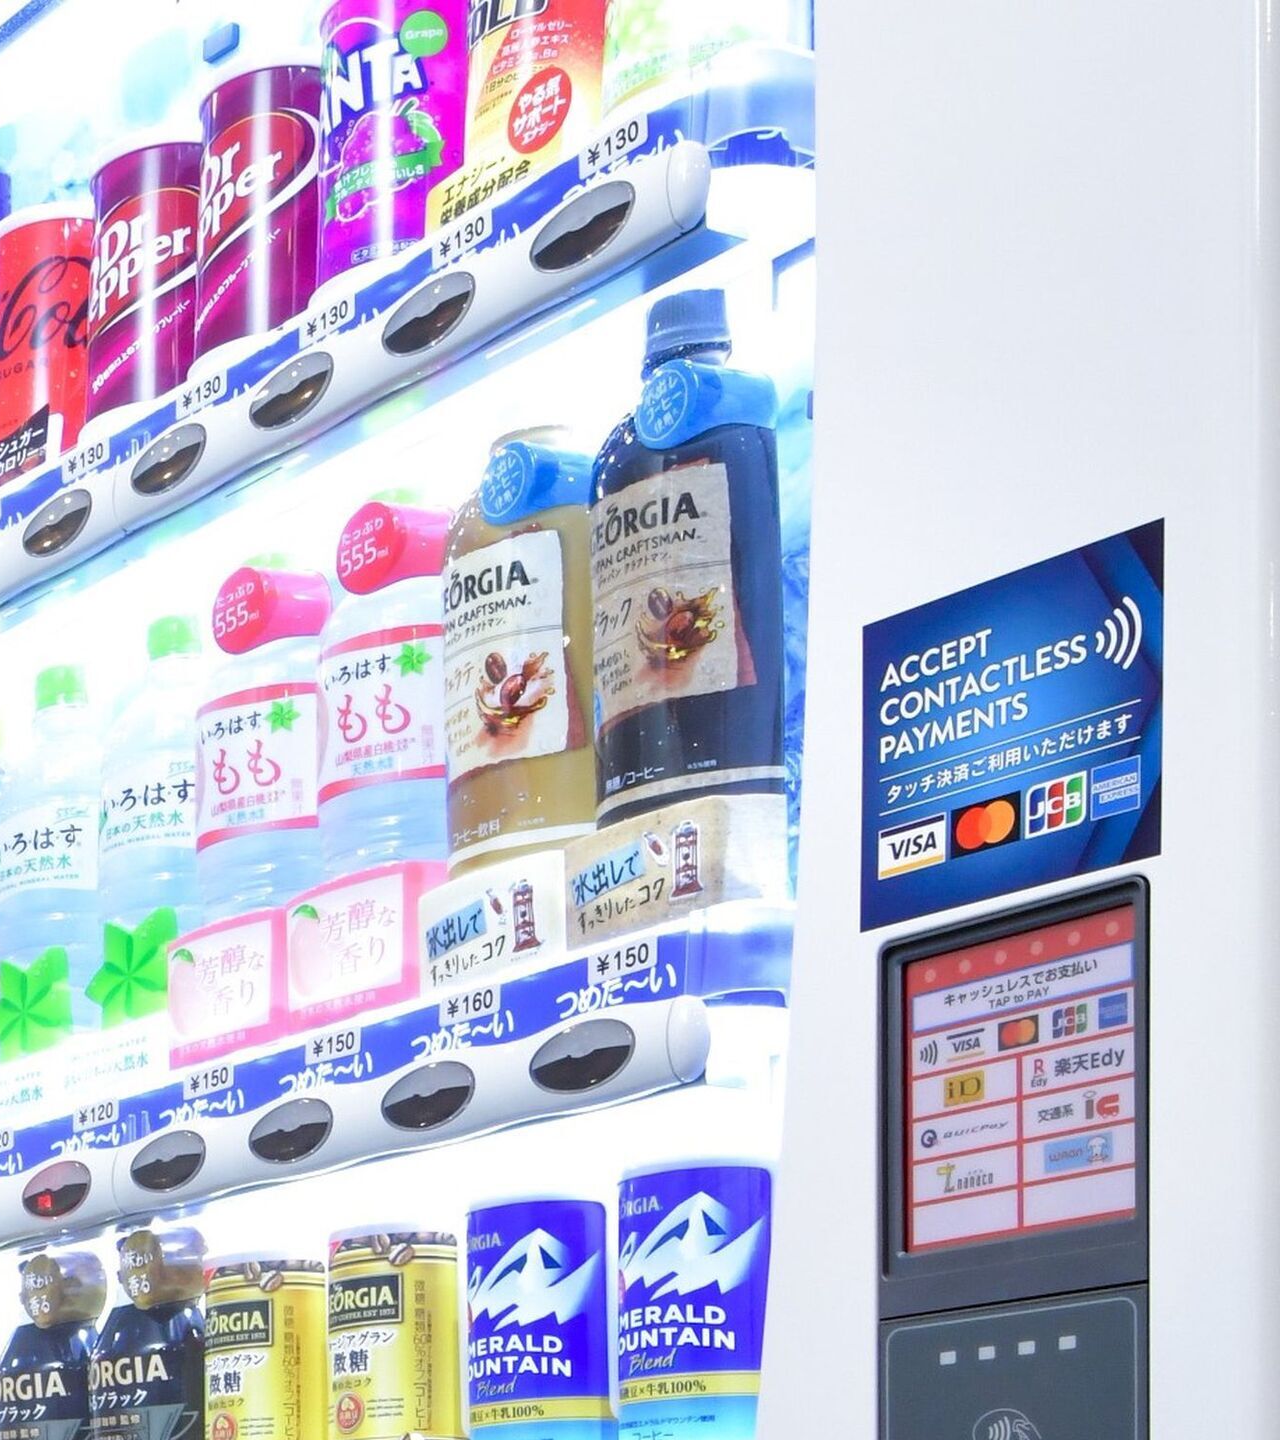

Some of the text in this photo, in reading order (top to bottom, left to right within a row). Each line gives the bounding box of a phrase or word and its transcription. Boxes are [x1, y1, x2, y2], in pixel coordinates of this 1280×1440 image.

[519, 75, 561, 114] やる気
[514, 98, 566, 136] サポート
[588, 121, 639, 166] ¥130
[439, 216, 486, 258] ¥130
[307, 301, 348, 337] ¥130
[182, 375, 221, 409] ¥130
[646, 390, 682, 424] コーヒー
[68, 443, 104, 473] ¥130
[341, 517, 384, 547] たっぷり
[616, 529, 697, 561] CRAFTSMAN
[340, 538, 389, 578] 555ml
[216, 583, 255, 610] たっぷり
[459, 594, 527, 630] CRAFTSMAN
[216, 601, 259, 638] 555ml
[879, 628, 992, 694] ACCEPT
[879, 635, 1087, 726] CONTACTLESS
[337, 683, 411, 743] もも
[879, 692, 1028, 764] PAYMENTS
[213, 739, 282, 795] もも
[887, 713, 1133, 804] タッチ決済ご利用いただけます
[1091, 773, 1137, 793] AMERICAN
[1100, 784, 1140, 803] EXPRESS
[453, 822, 500, 846] コーヒー飲料
[889, 831, 938, 861] VISA
[578, 878, 666, 934] すっきりしたコク
[340, 936, 385, 976] 香り
[431, 935, 506, 986] すっきりしたコク
[596, 942, 650, 975] ¥150
[212, 979, 254, 1017] 香り
[944, 958, 1098, 1007] キャッシュレスでお支払い
[989, 987, 1050, 1010] TAP to PAY
[447, 990, 494, 1018] ¥160
[313, 1031, 355, 1057] ¥150
[952, 1037, 981, 1054] VISA
[1055, 1048, 1125, 1076] 楽天Edy
[190, 1067, 228, 1093] ¥150
[78, 1102, 114, 1126] ¥120
[1037, 1103, 1074, 1123] 交通系
[957, 1169, 994, 1190] nanaco
[128, 1276, 150, 1297] 香る
[29, 1295, 50, 1315] 香る
[333, 1349, 369, 1376] 微糖
[629, 1348, 677, 1376] Blend
[209, 1370, 241, 1396] 微糖
[476, 1376, 517, 1399] Blend
